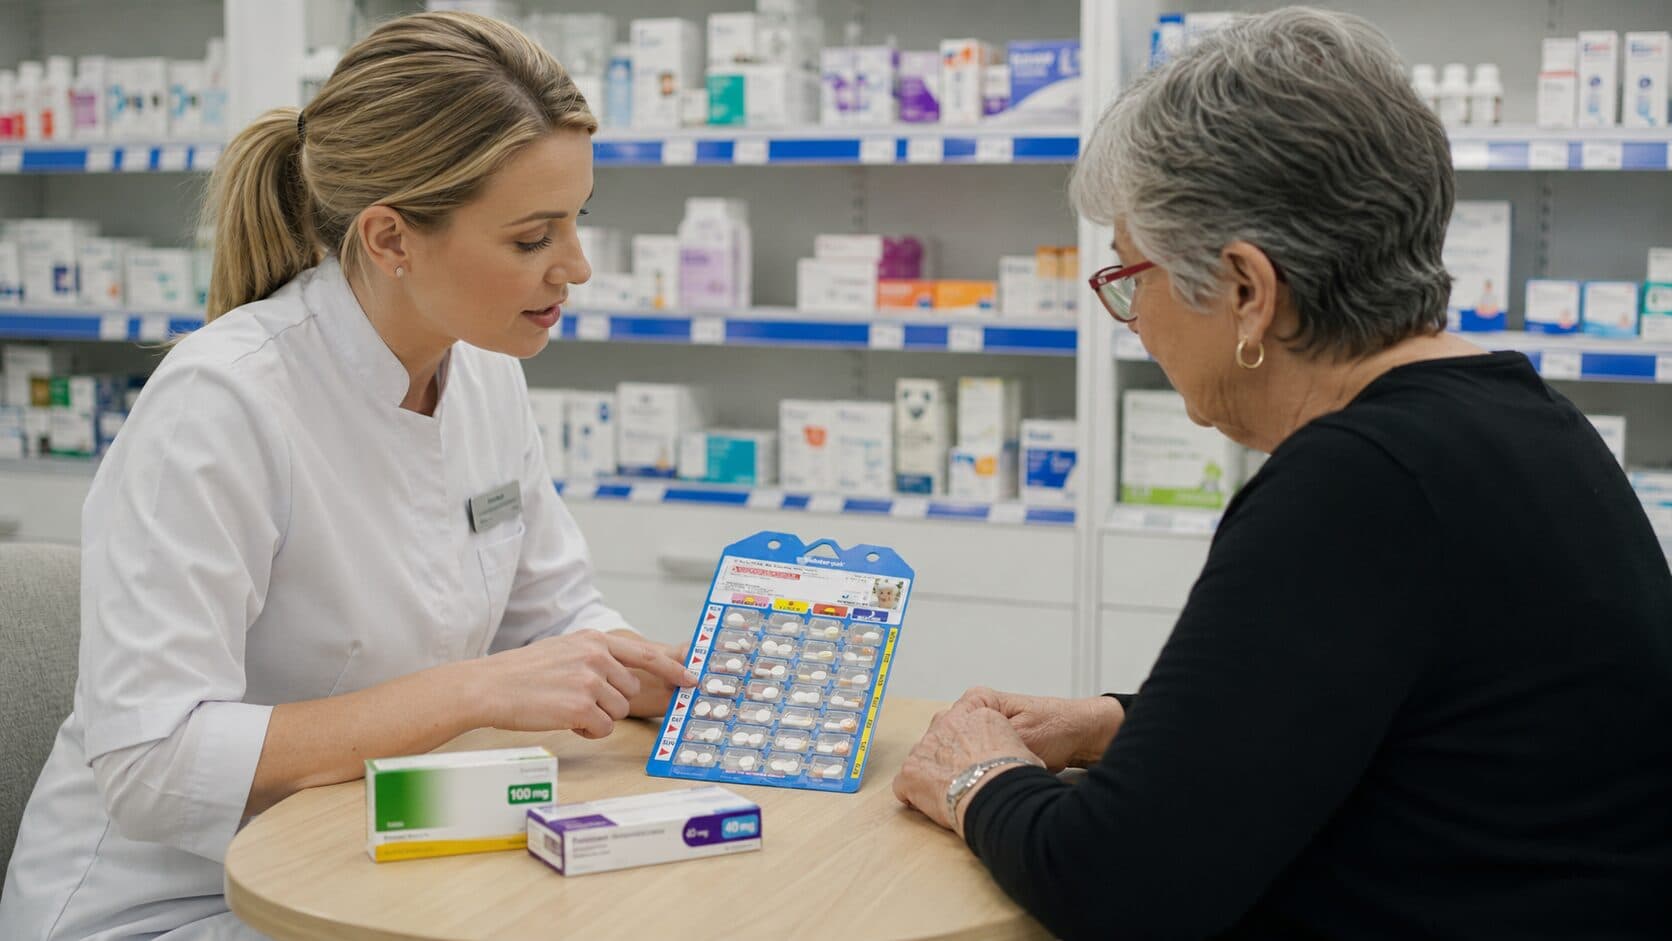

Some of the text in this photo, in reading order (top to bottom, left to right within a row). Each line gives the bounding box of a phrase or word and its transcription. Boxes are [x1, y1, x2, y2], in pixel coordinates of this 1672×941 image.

[510, 788, 550, 801] 100 mg
[725, 821, 755, 833] 40 mg
[685, 828, 709, 839] 40 mg
